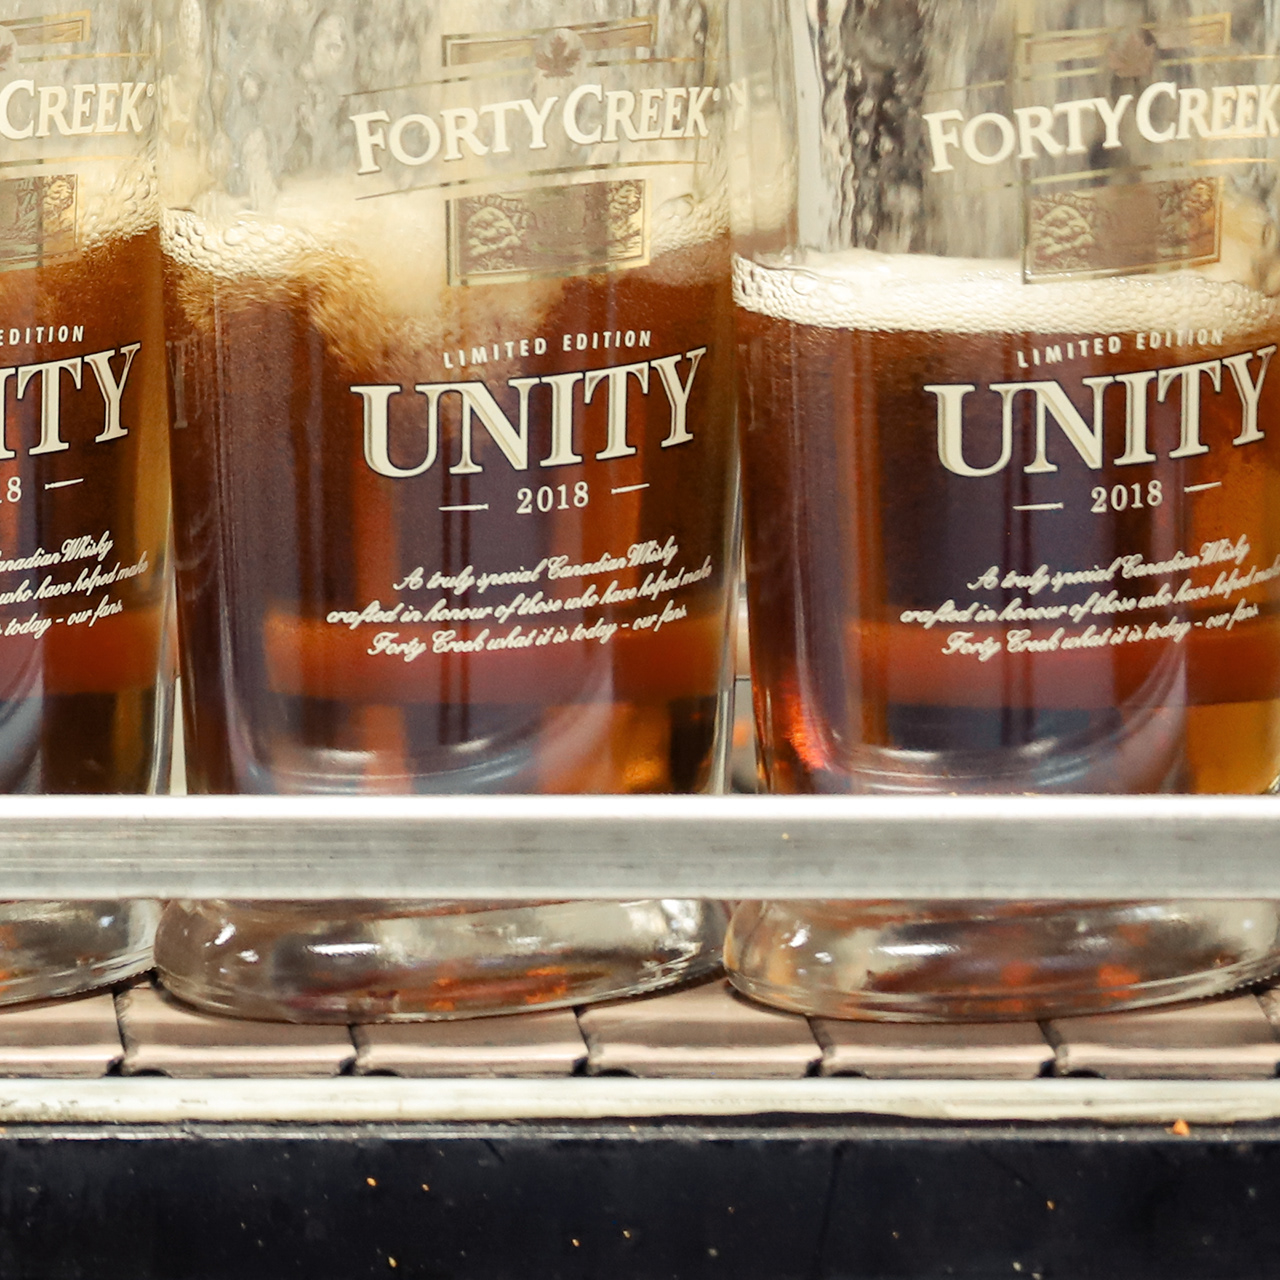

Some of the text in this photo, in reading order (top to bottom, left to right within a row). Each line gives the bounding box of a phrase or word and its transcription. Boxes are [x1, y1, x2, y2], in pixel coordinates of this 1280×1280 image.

[349, 96, 558, 175] FORTY
[922, 81, 1280, 173] FORTY CREEK
[443, 330, 652, 369] LIMITED EDITION
[1017, 328, 1224, 368] LIMITED EDITION
[350, 346, 707, 478] UNITY
[923, 344, 1277, 478] UNITY
[516, 481, 589, 514] 2018
[1091, 480, 1163, 512] 2018
[60, 530, 114, 563] Whisky
[32, 574, 71, 601] have
[69, 561, 121, 597] helped
[3, 612, 53, 640] today
[66, 608, 93, 626] our
